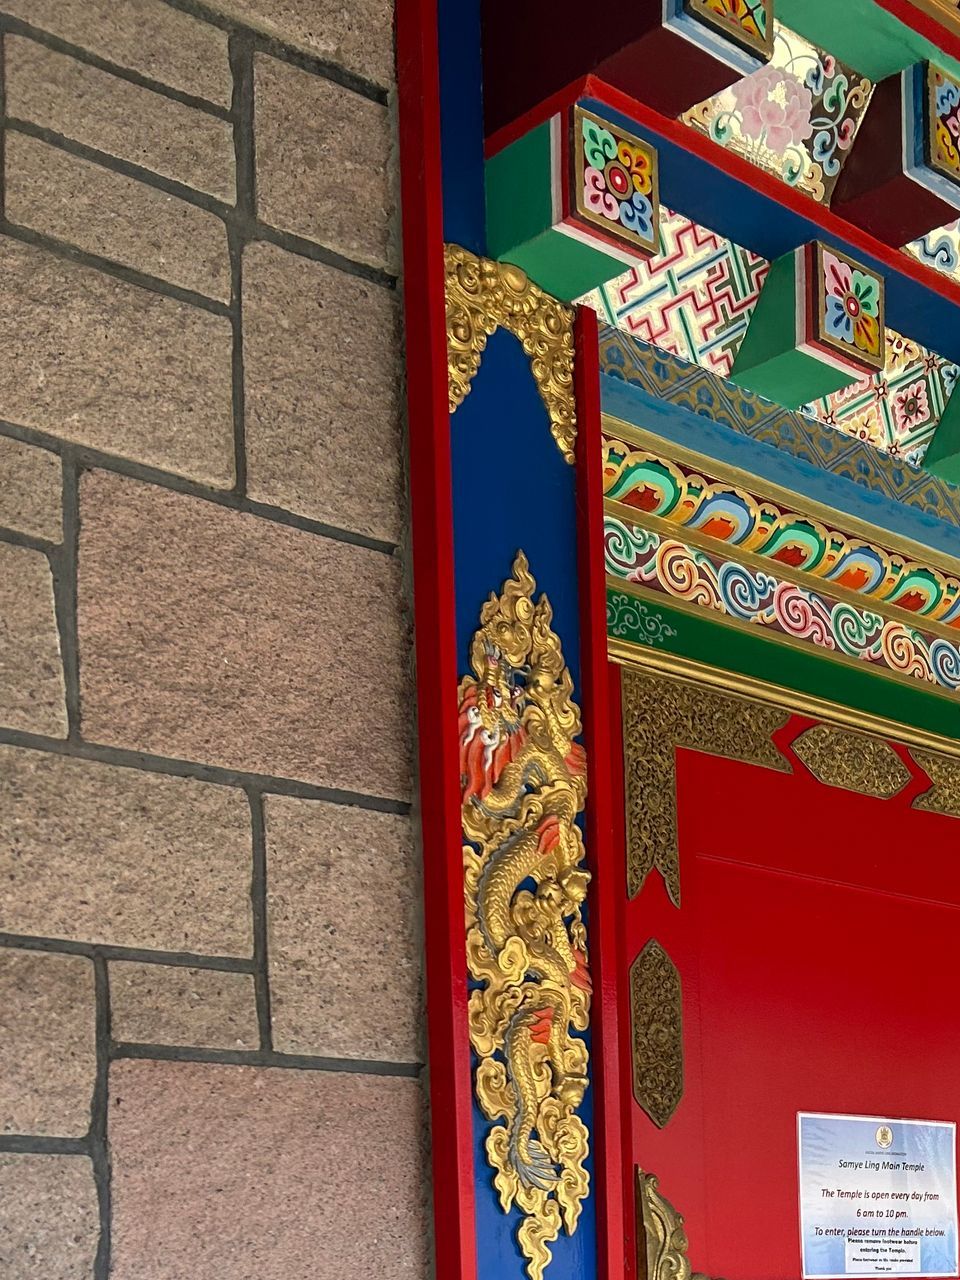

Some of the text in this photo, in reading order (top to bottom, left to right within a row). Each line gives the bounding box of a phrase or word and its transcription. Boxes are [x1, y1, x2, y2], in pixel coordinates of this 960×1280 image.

[839, 1159, 925, 1172] Samye Ling Main Temple
[822, 1189, 939, 1202] The Temple is open every day from
[857, 1209, 861, 1217] 6
[895, 1211, 908, 1219] pm.
[815, 1227, 824, 1235] To
[825, 1228, 846, 1238] enter,
[847, 1228, 870, 1238] please
[888, 1228, 900, 1236] the
[901, 1228, 924, 1237] handle
[925, 1229, 946, 1237] below.
